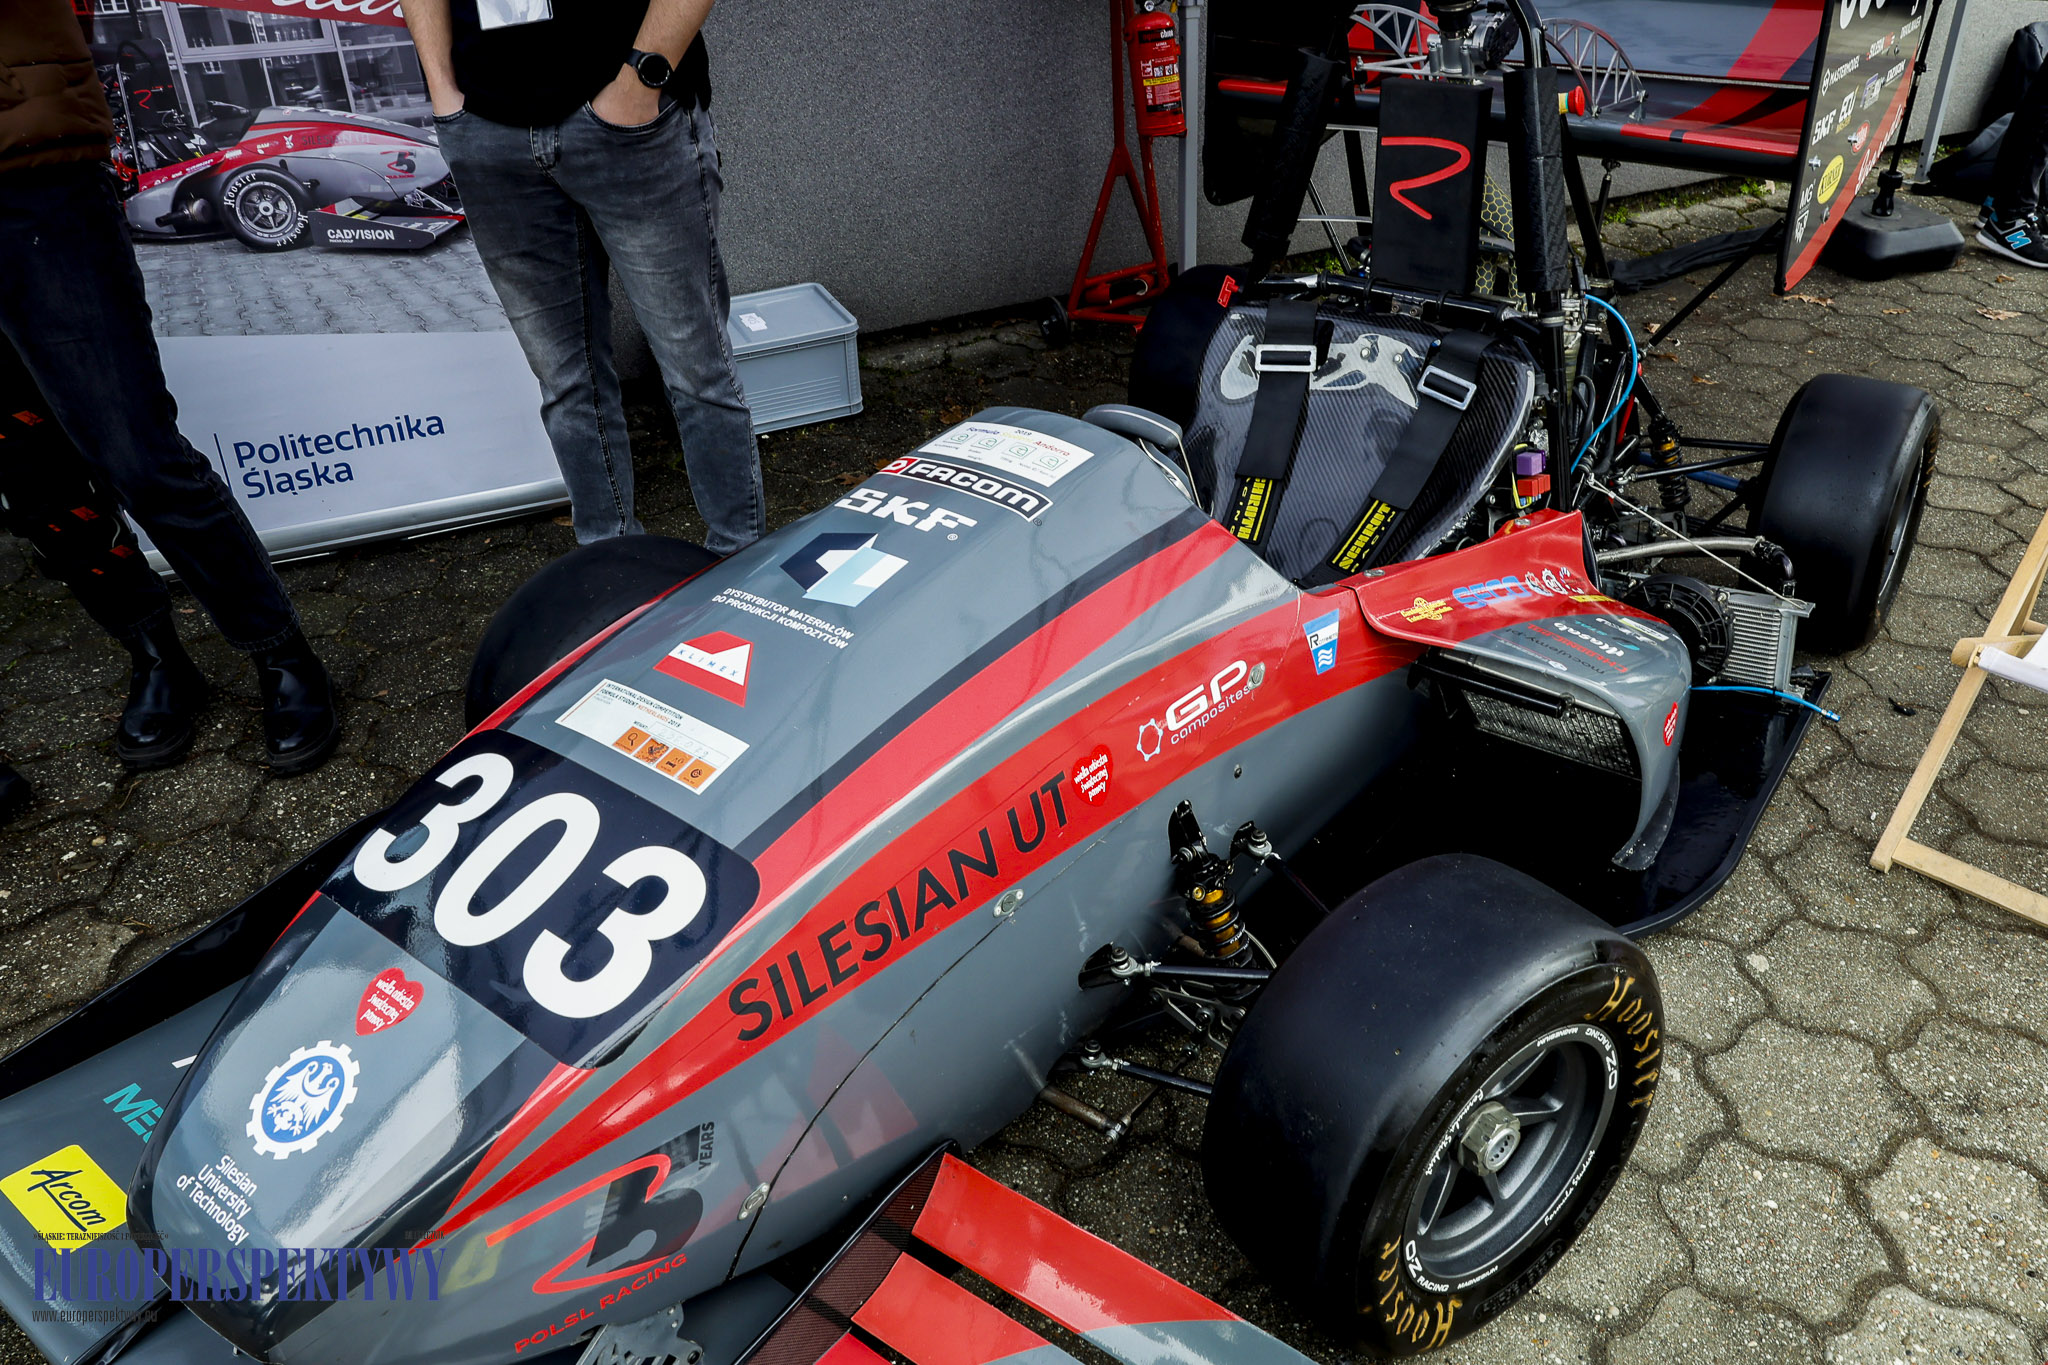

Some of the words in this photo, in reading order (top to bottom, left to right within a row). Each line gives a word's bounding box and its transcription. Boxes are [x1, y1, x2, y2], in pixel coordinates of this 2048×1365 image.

[1812, 109, 1837, 146] SKF
[223, 171, 257, 209] Hoosier
[326, 229, 396, 241] CADVISION
[233, 414, 445, 469] Politechnika
[242, 461, 354, 499] Śląska
[908, 462, 1041, 513] FACOM
[834, 487, 978, 532] SKF
[1237, 478, 1267, 540] HROTH
[1338, 502, 1392, 570] SCHROT
[723, 587, 788, 615] DYSTRYBUTOR
[788, 607, 855, 641] MATERIAŁÓW
[1452, 575, 1532, 609] SECO
[711, 594, 726, 604] DO
[725, 596, 779, 623] PRODUKCJI
[777, 616, 849, 650] KOMPOZYTÓW
[677, 648, 738, 678] KLIMEX
[1505, 628, 1606, 675] mocujemy.pl
[1165, 660, 1248, 732] GP
[1170, 685, 1251, 745] composites
[353, 752, 707, 1019] 303
[728, 826, 999, 1042] SILESIAN
[1006, 770, 1066, 854] UT
[103, 1082, 164, 1144] ME
[699, 1121, 716, 1171] YEARS
[27, 1168, 107, 1231] Arcom
[196, 1164, 252, 1221] University
[219, 1154, 258, 1198] Silesian
[176, 1173, 194, 1190] of
[186, 1181, 251, 1247] Technology
[514, 1308, 595, 1353] POLSL
[598, 1252, 688, 1310] RACING
[1417, 1275, 1449, 1293] RACING
[1457, 1265, 1499, 1290] MAGNESIUM
